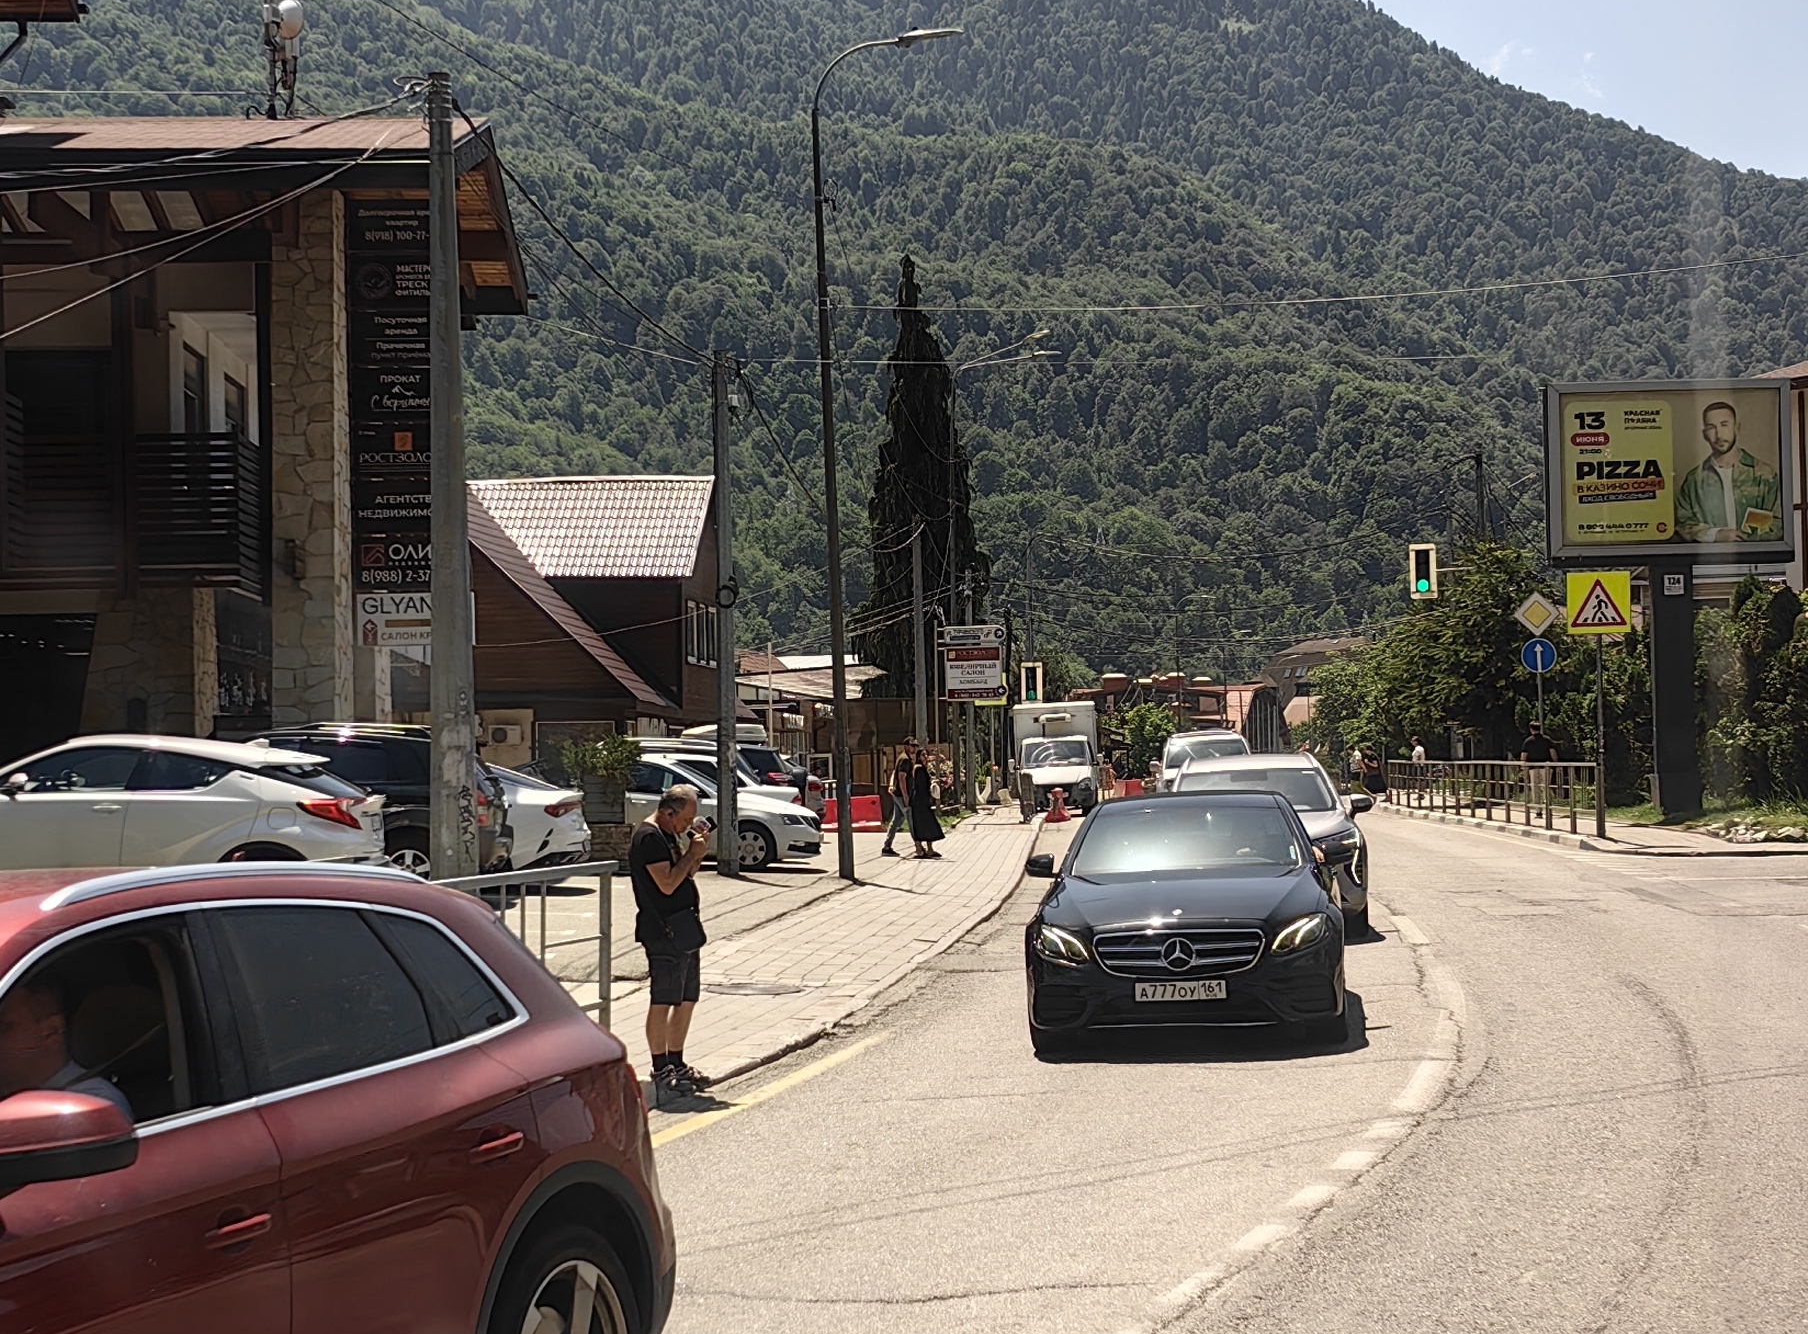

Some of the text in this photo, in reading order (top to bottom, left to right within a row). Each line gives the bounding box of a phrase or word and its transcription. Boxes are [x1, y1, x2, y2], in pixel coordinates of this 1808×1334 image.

[380, 375, 422, 383] ПРОКАТ
[1574, 411, 1606, 430] 13
[1576, 459, 1663, 481] PIZZA
[1577, 485, 1584, 493] В
[1586, 482, 1630, 493] КАЗИНО
[361, 569, 402, 585] 8(988)
[381, 631, 417, 641] САЛОН
